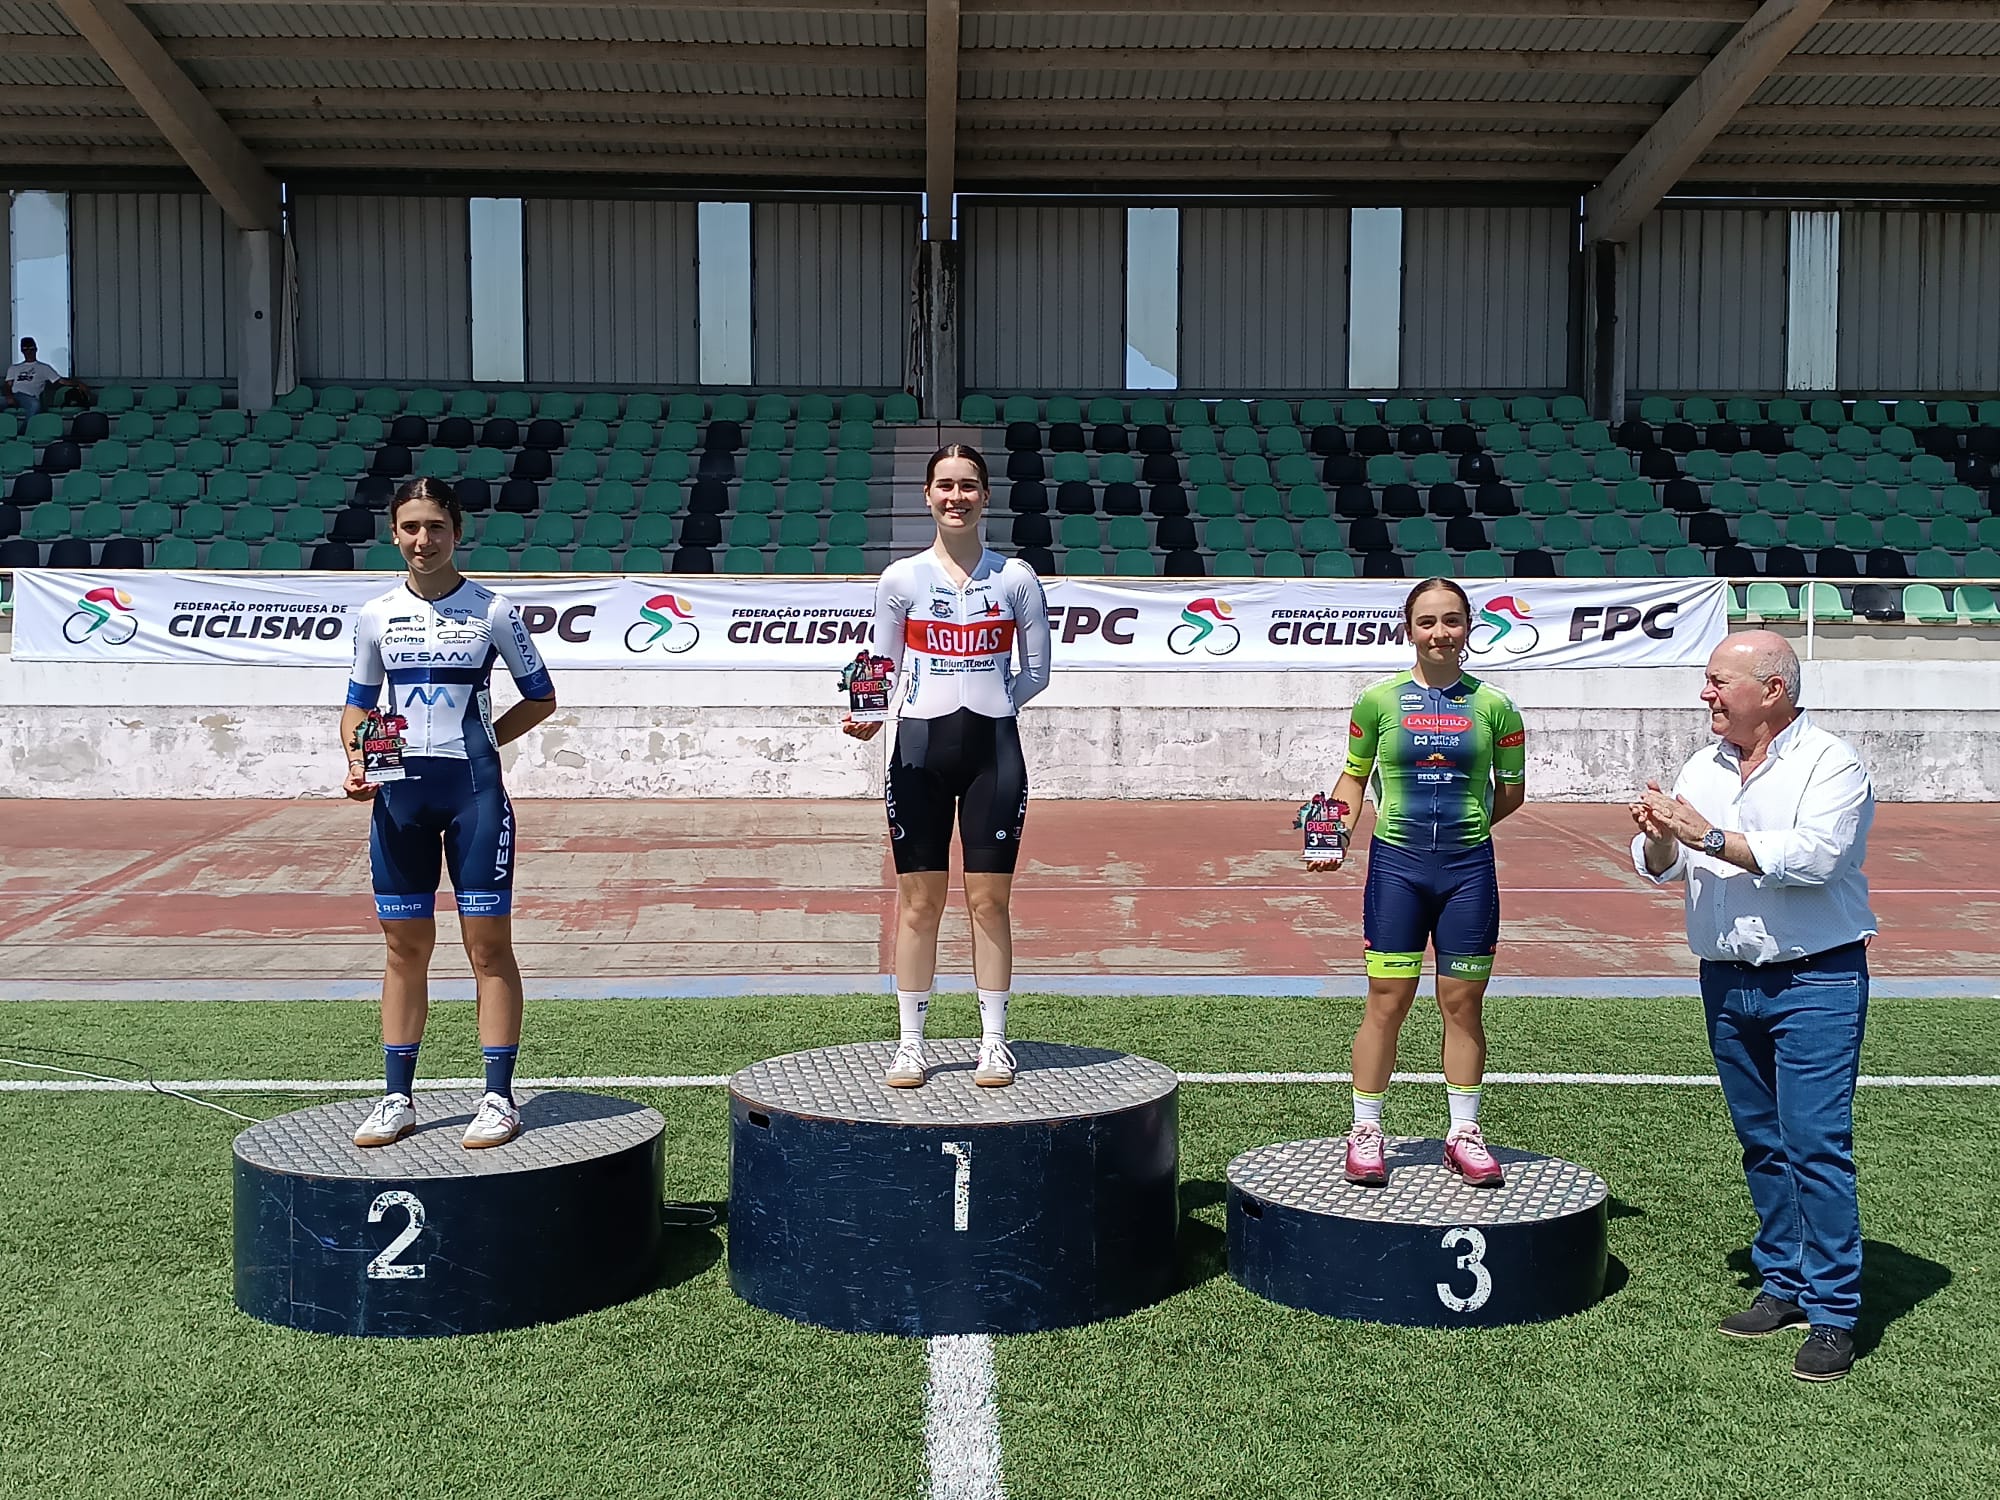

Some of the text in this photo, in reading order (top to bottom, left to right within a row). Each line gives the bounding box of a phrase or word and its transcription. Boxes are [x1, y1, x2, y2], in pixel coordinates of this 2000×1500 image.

[174, 600, 348, 614] FEDERAÇÃO PORTUGUESA DE
[731, 606, 800, 619] FEDERAÇÃO
[1271, 607, 1404, 620] FEDERAÇÃO PORTUGUE
[168, 614, 343, 640] CICLISMO
[513, 604, 596, 643] PC
[1568, 602, 1679, 642] FPC
[508, 609, 537, 672] VESAM
[926, 623, 1003, 653] ÁGUIAS
[1267, 622, 1404, 646] CICLISM
[388, 651, 473, 663] VESAM
[852, 681, 885, 693] PISTA
[365, 738, 399, 751] PISTA
[367, 752, 383, 768] 2º
[1306, 821, 1339, 832] PISTA
[1309, 832, 1323, 846] 3º
[941, 1140, 973, 1231] 1
[366, 1189, 426, 1279] 2
[1436, 1226, 1493, 1313] 3
